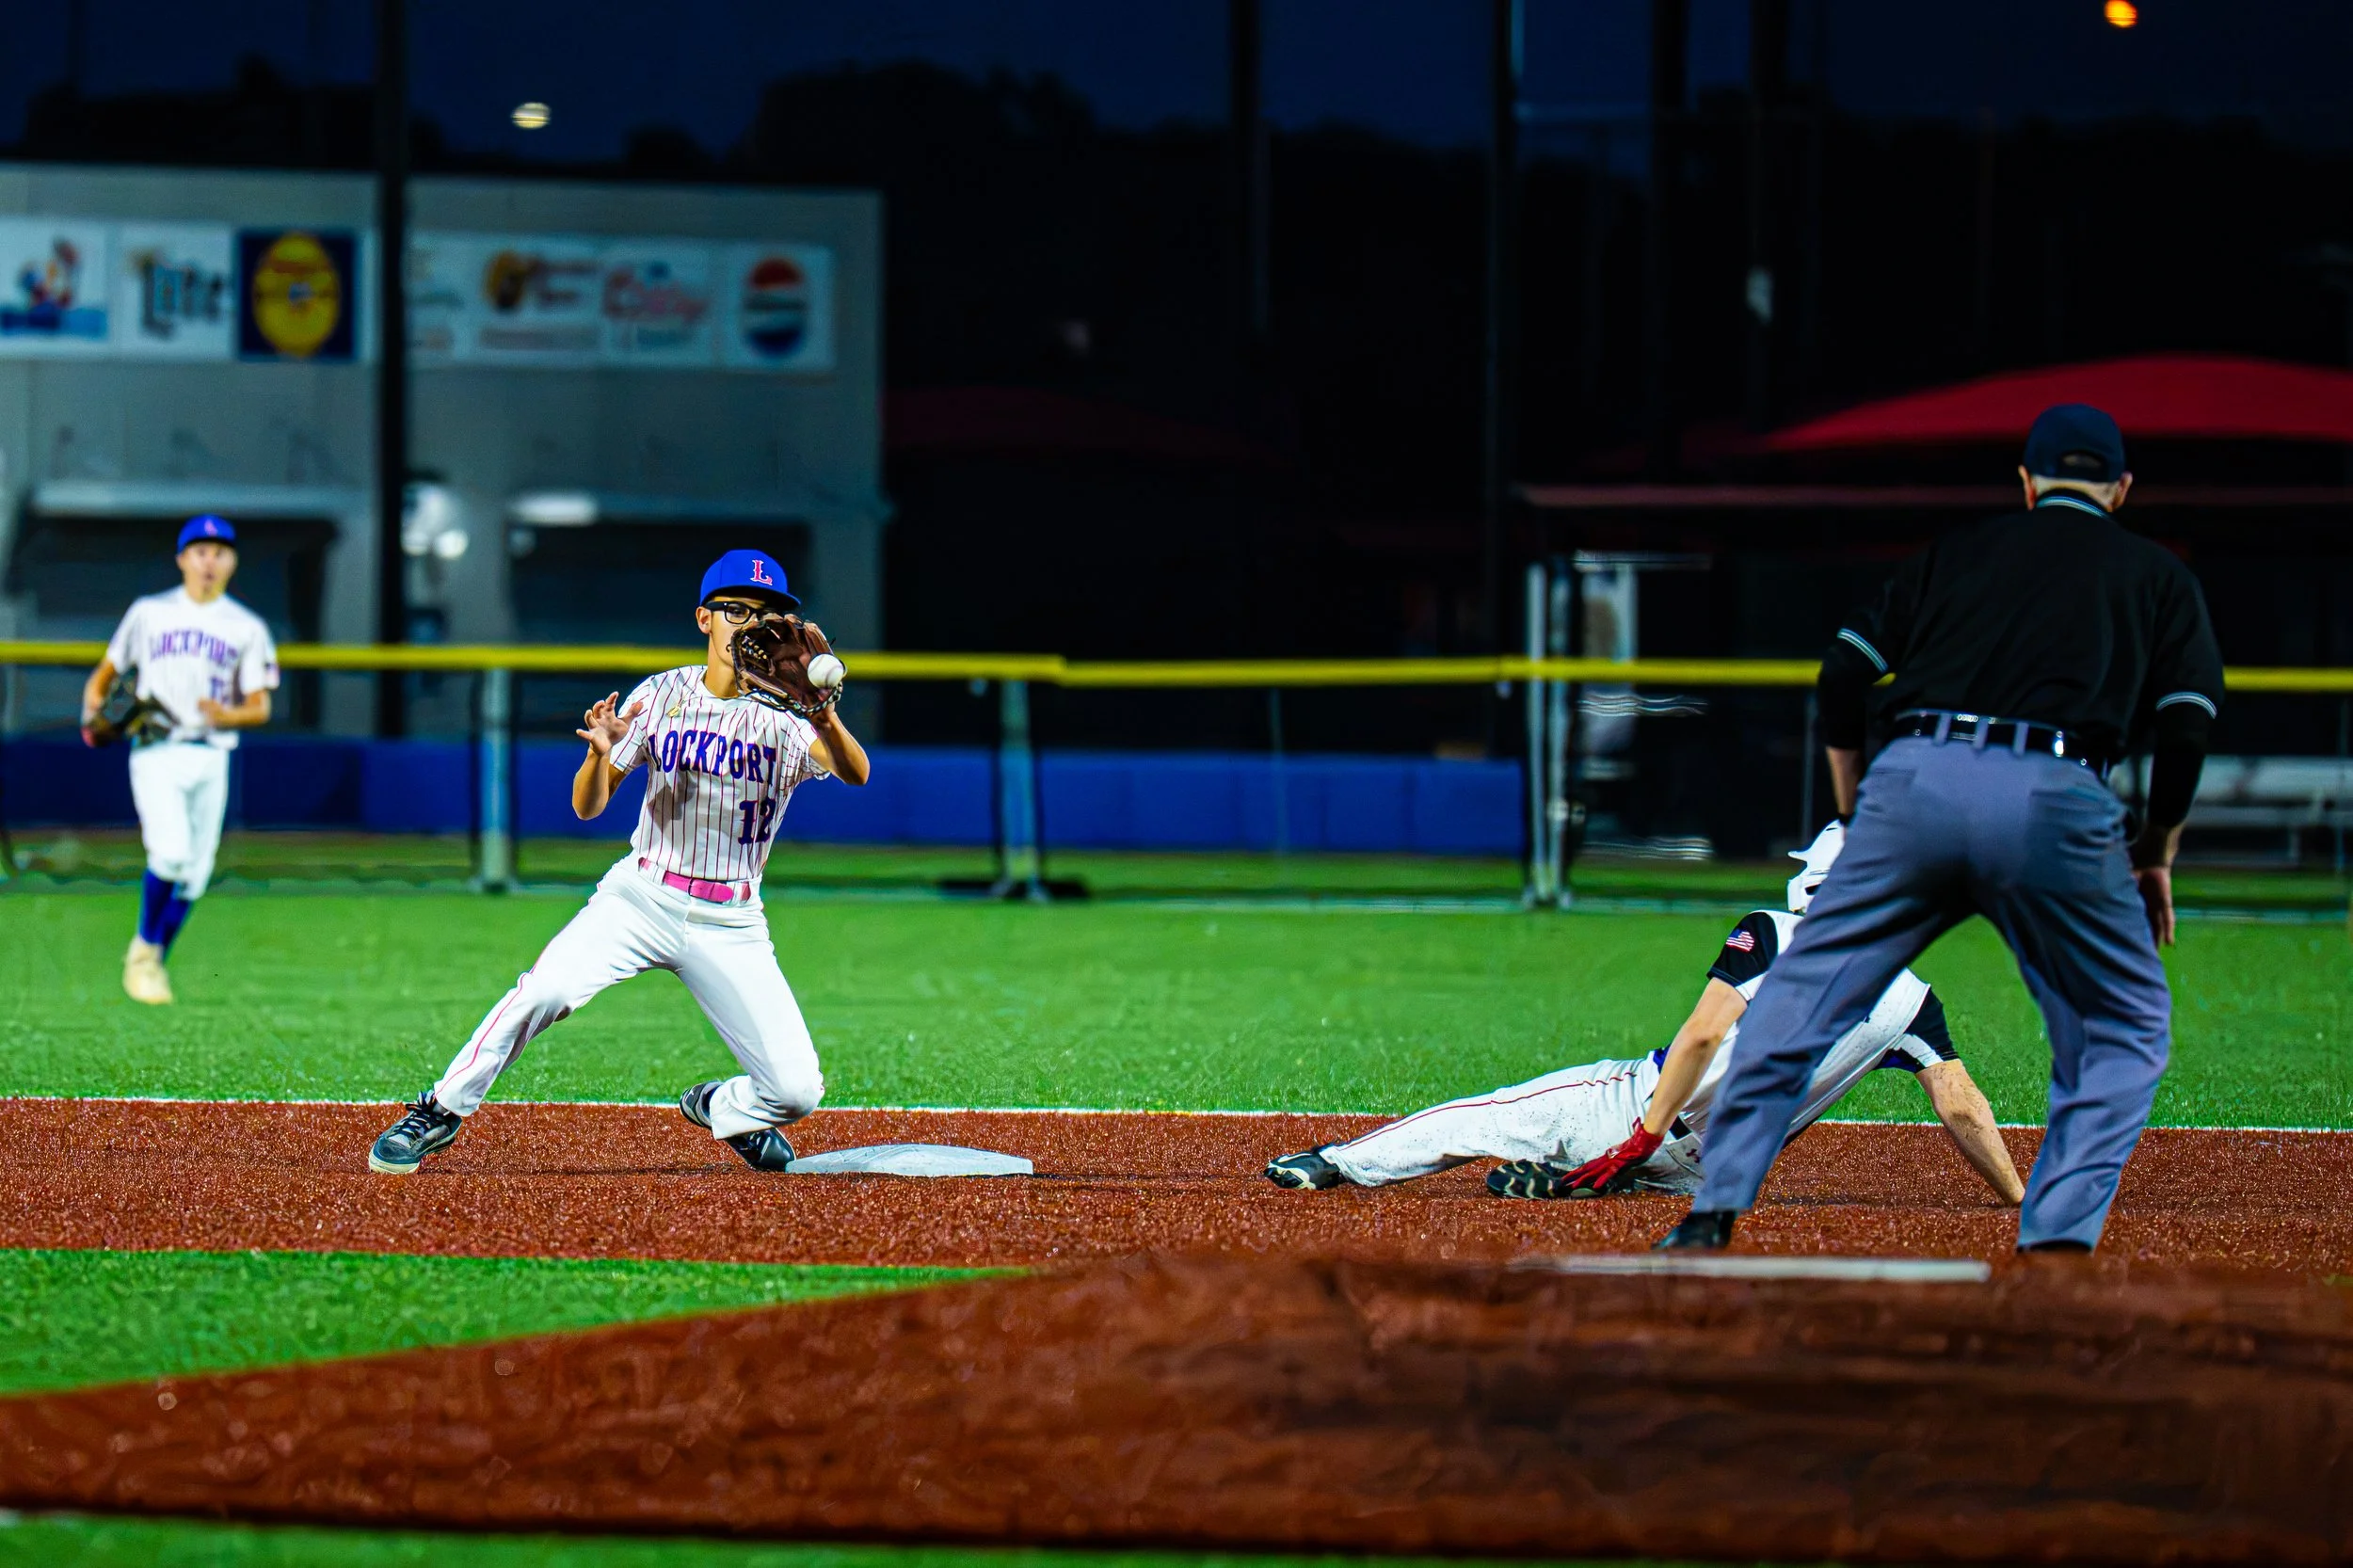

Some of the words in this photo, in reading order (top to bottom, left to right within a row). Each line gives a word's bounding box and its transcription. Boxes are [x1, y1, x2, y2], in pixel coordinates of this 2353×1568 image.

[750, 559, 773, 586] L
[648, 729, 777, 788] LOCKPORT
[738, 796, 777, 845] 12
